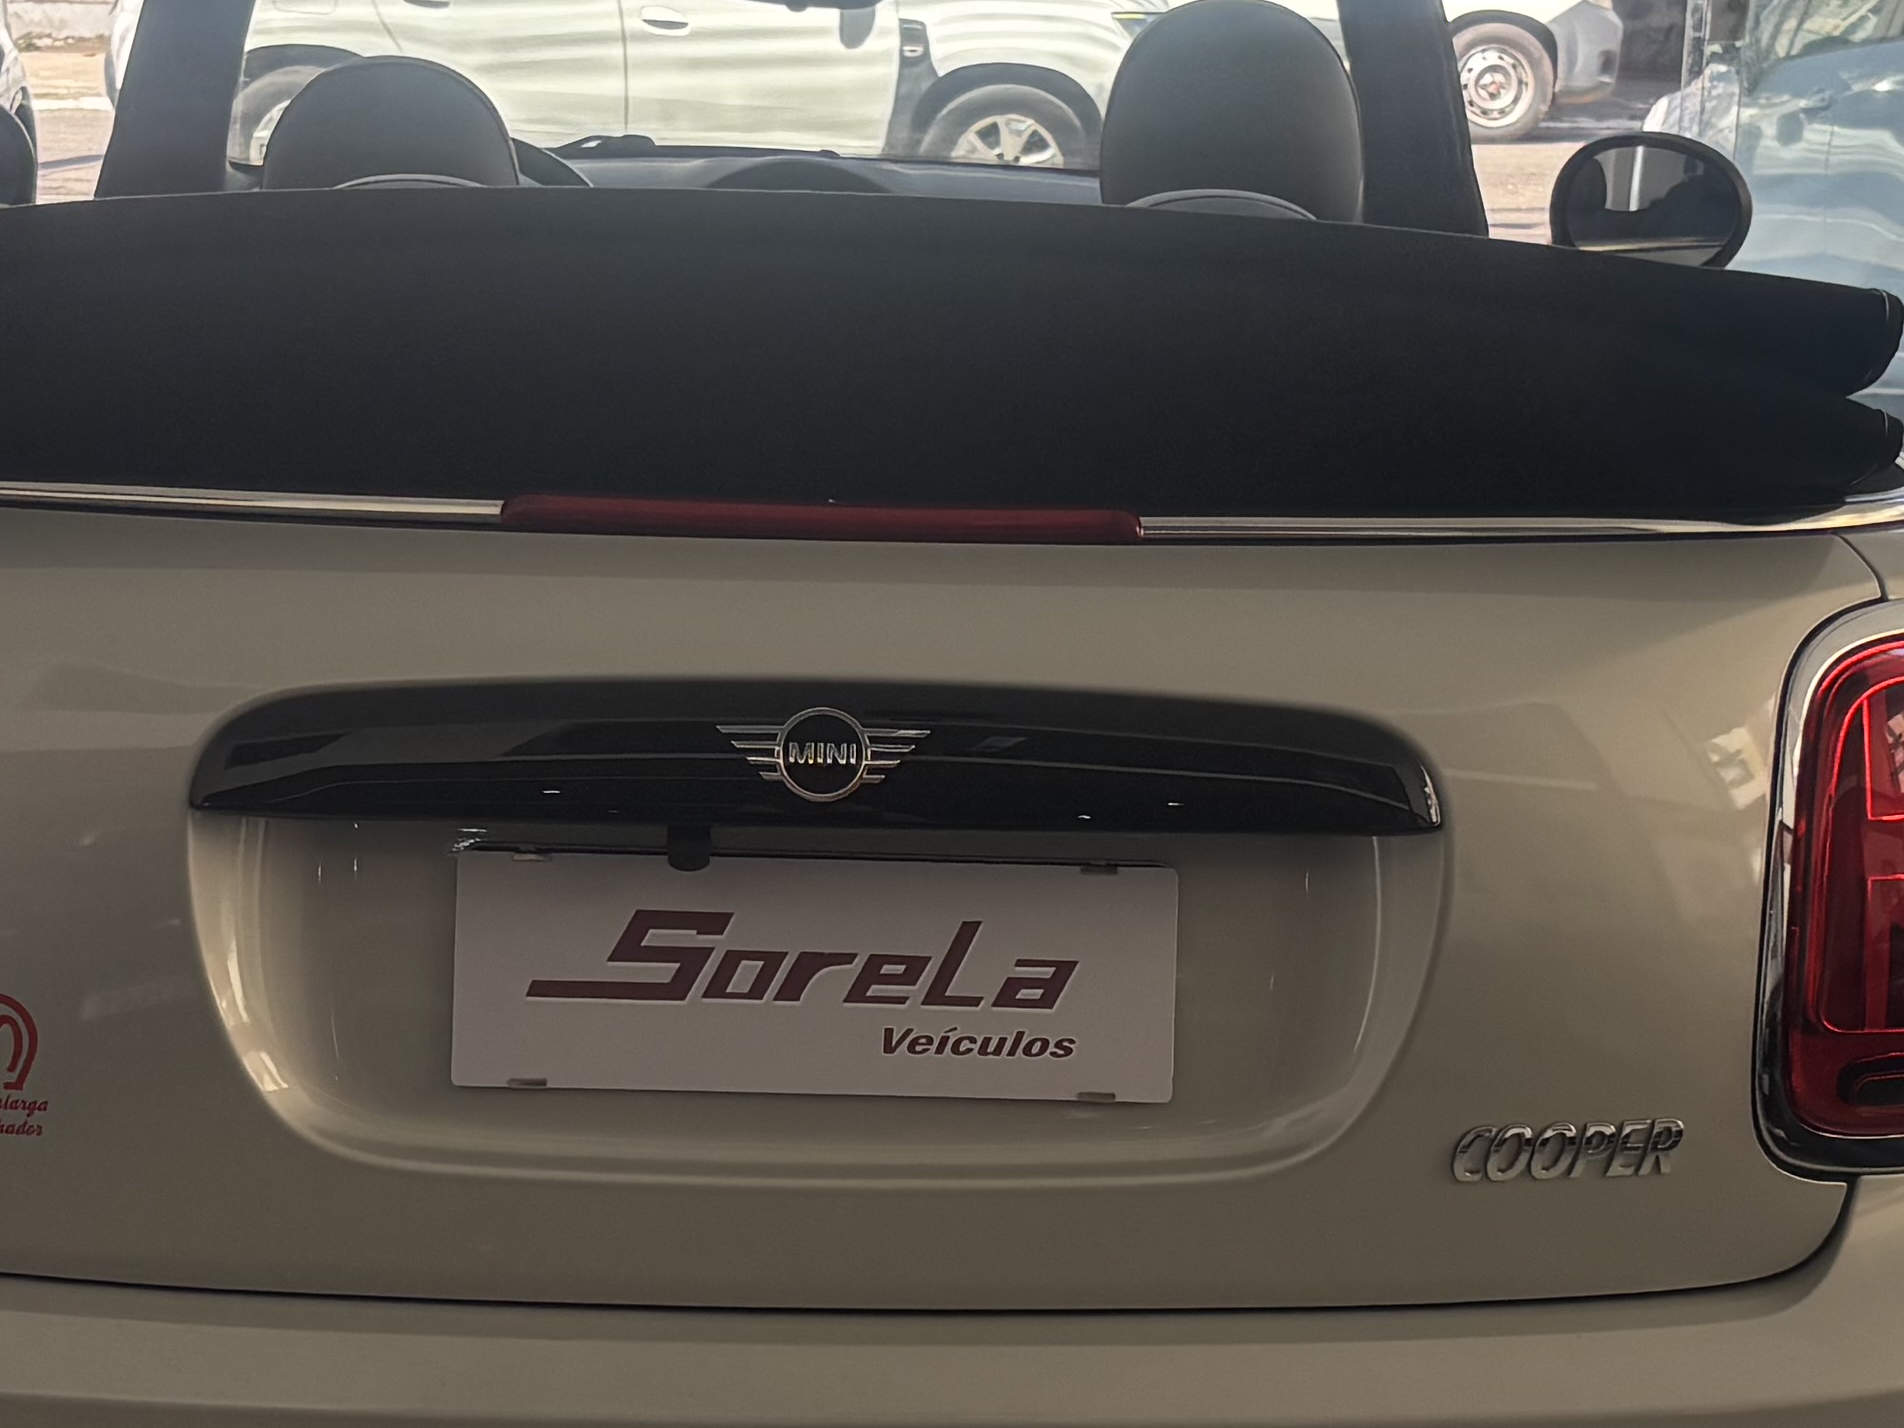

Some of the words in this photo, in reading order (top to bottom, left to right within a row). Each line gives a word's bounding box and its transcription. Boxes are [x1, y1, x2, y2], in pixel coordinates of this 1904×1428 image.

[788, 741, 857, 765] MINI
[881, 1025, 1076, 1060] Veículos
[1451, 1118, 1685, 1182] COOPER
